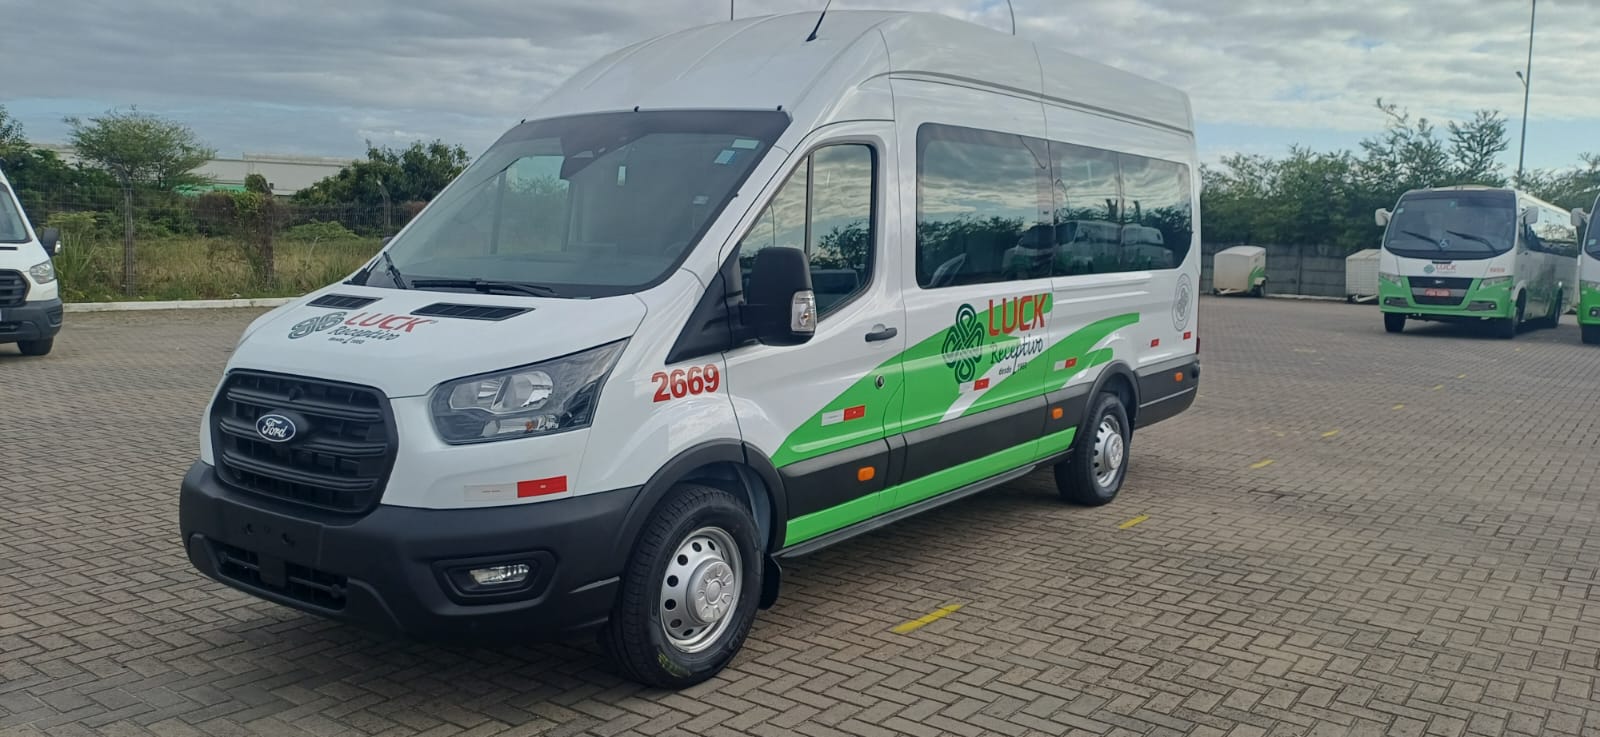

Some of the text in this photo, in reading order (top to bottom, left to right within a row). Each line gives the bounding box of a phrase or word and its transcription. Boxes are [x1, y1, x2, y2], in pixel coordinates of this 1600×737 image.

[344, 312, 433, 333] LUCK
[988, 292, 1050, 336] LUCK
[327, 325, 400, 344] Receptivo
[990, 334, 1044, 375] Receptivo
[651, 363, 720, 403] 2669
[262, 417, 289, 438] Ford
